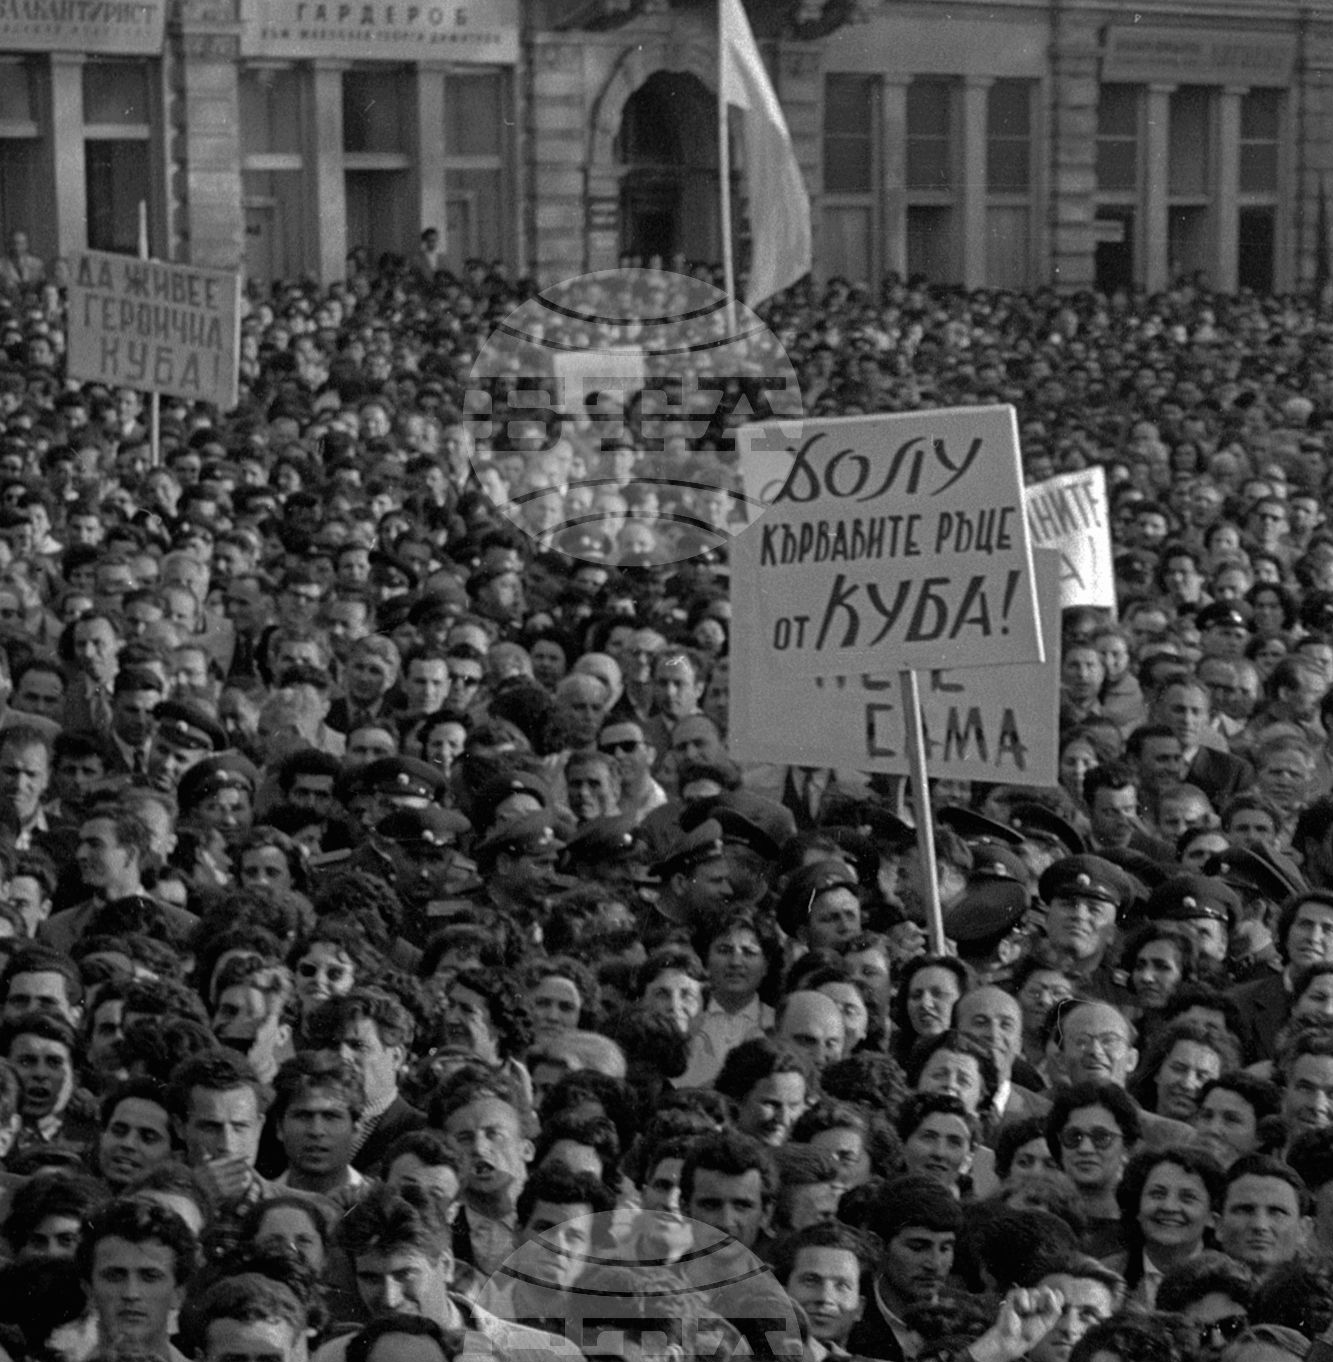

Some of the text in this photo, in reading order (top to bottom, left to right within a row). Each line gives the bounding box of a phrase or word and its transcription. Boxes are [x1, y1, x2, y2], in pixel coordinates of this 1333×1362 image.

[297, 3, 468, 26] ГАРДЕРОБ
[78, 255, 220, 311] ДА ЖИВЕЕ
[760, 432, 983, 505] ДОЛУ
[760, 506, 1016, 567] КЪРВАВИТЕ РЪЦЕ
[815, 569, 1022, 651] КУБА!
